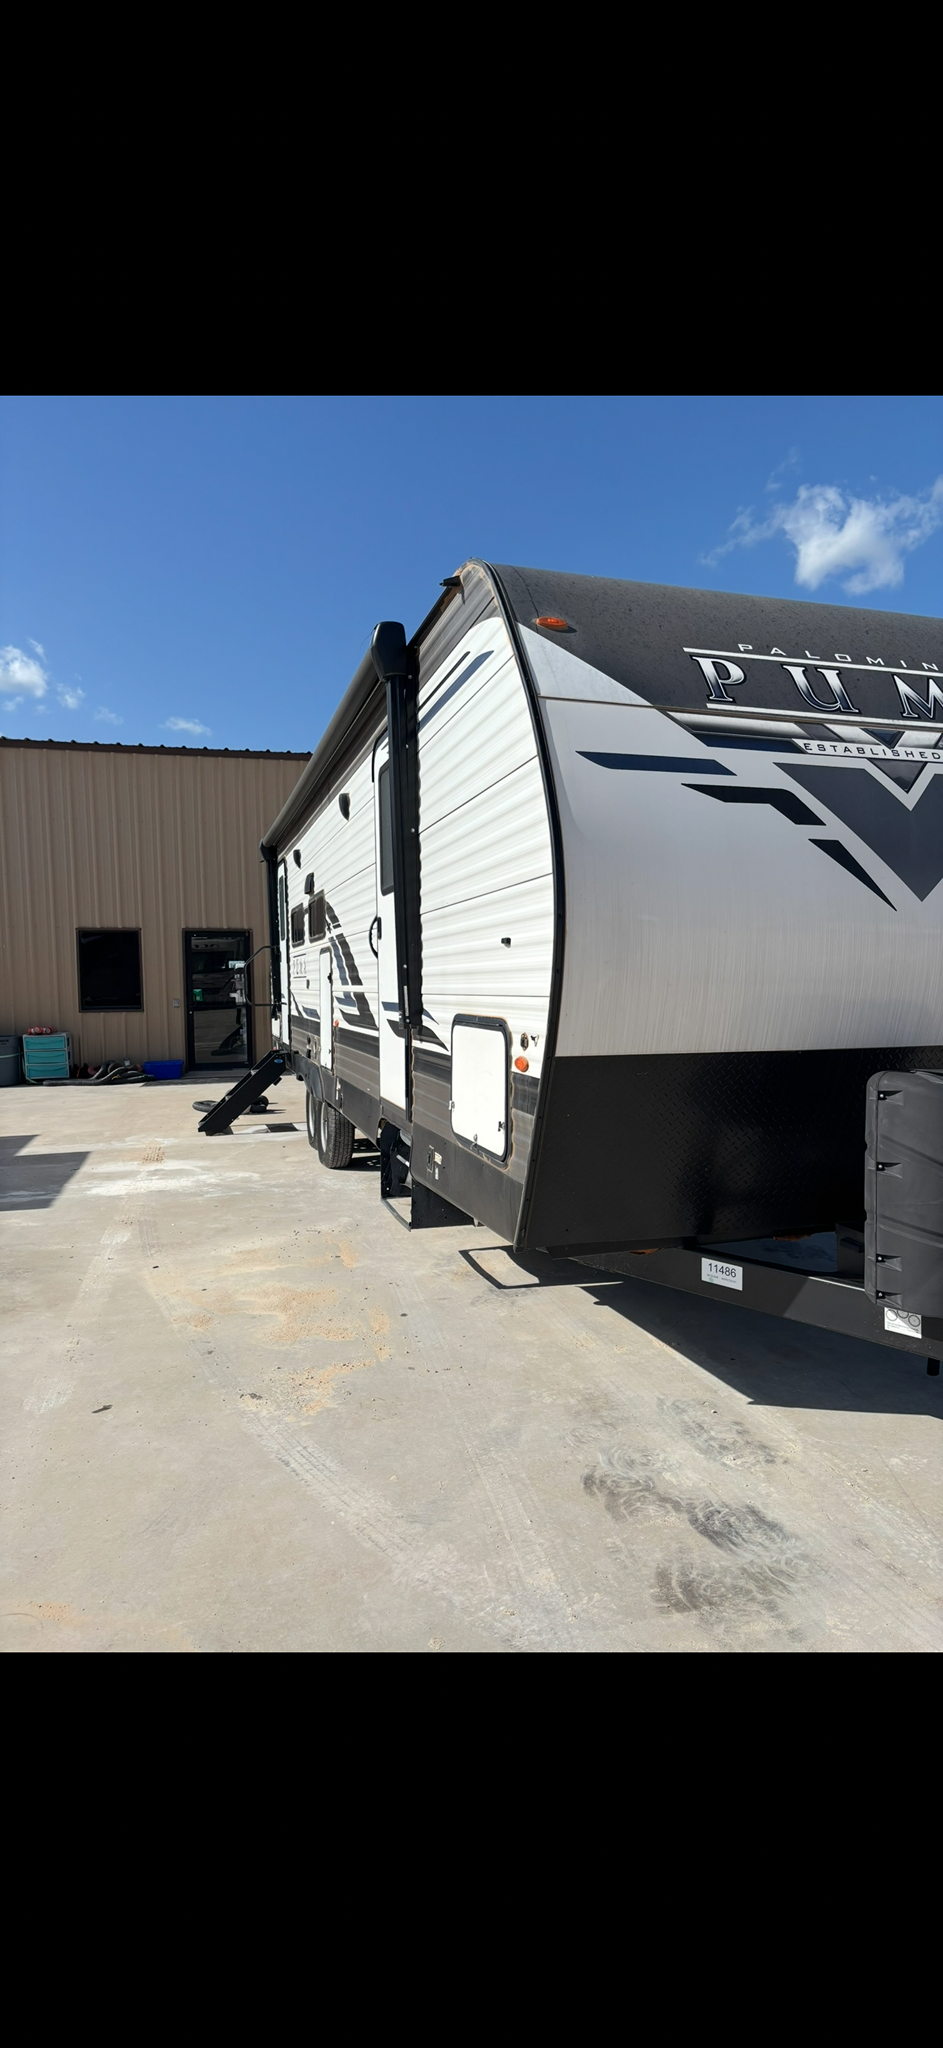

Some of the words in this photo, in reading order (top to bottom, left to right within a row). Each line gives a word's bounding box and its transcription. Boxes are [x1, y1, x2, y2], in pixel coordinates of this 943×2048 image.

[737, 643, 939, 671] PALOMIN
[803, 742, 941, 760] ESTABLISHED
[708, 1262, 737, 1278] 11486
